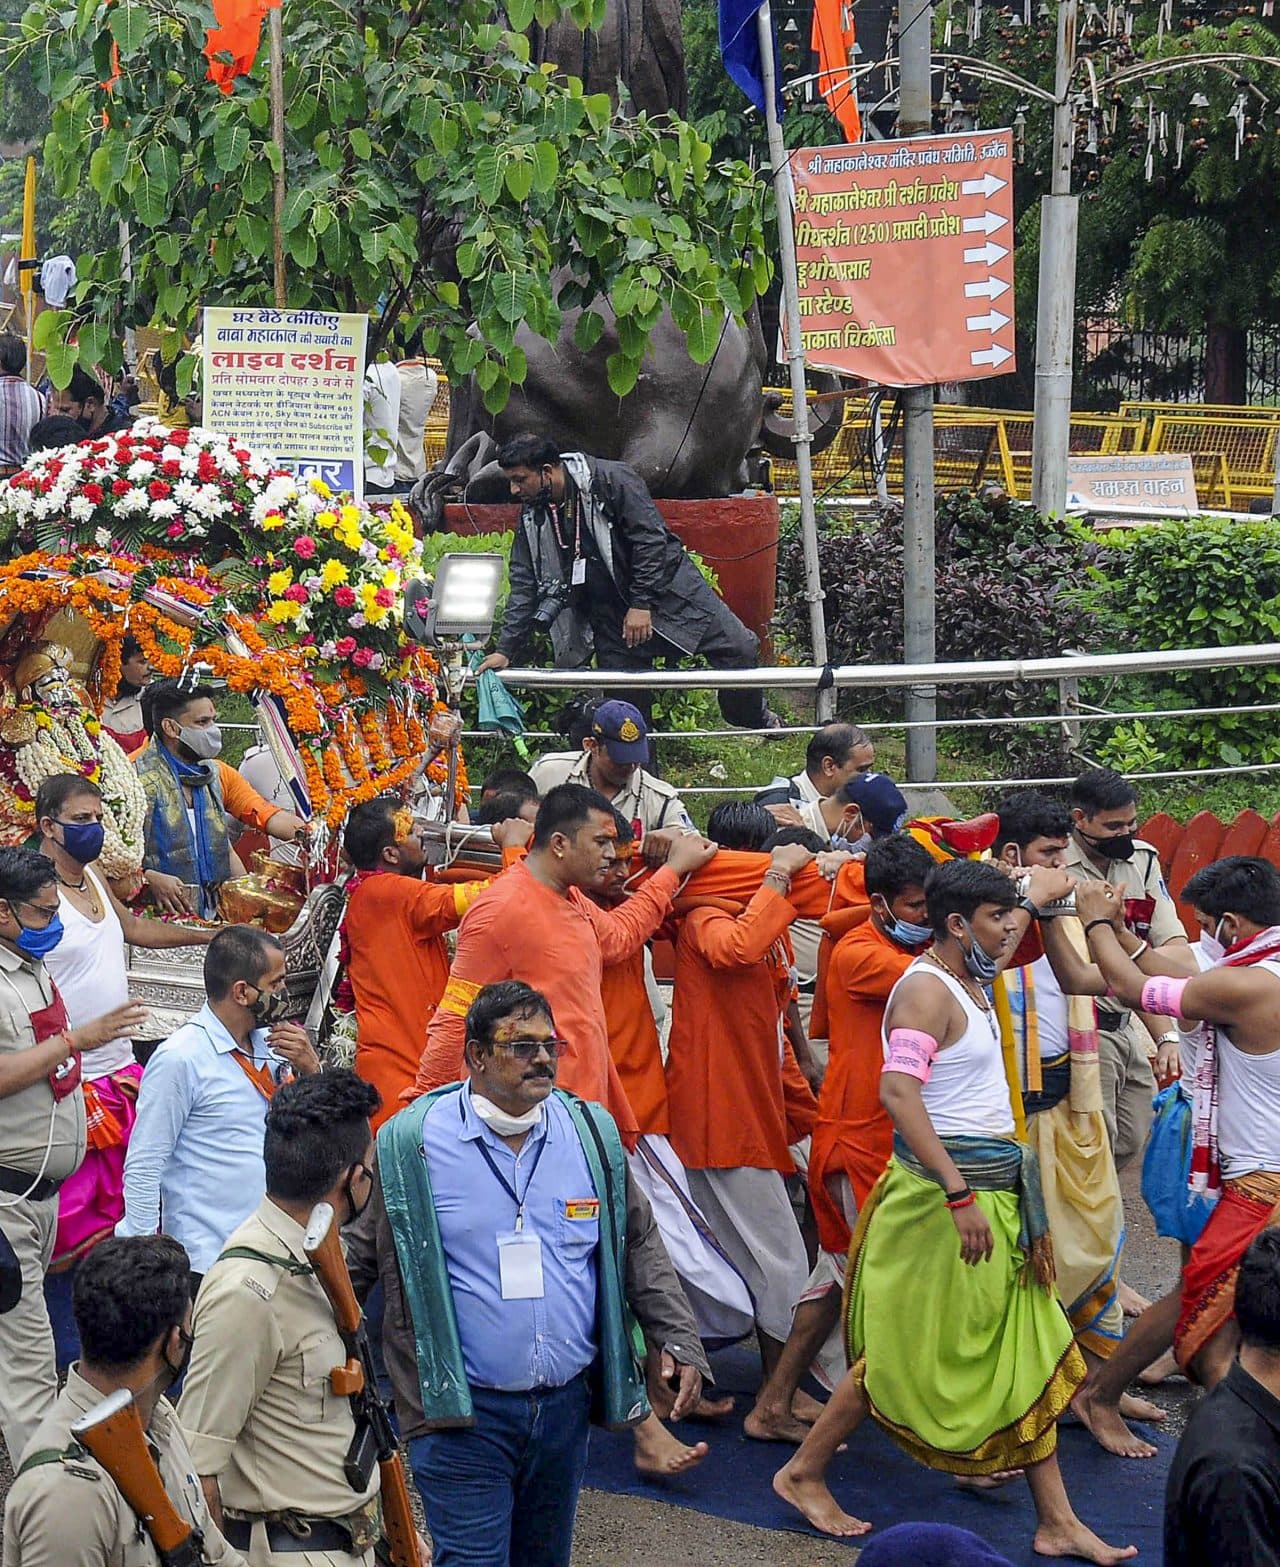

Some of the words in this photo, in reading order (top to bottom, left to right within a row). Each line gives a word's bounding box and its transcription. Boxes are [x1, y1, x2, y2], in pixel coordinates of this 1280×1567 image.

[808, 154, 822, 175] श्री
[823, 149, 887, 174] महाकालेश्वर
[888, 146, 916, 168] मंदिर
[809, 181, 881, 216] महाकालेश्वर
[899, 176, 928, 205] दर्शन
[928, 174, 959, 204] प्रवेश
[890, 210, 928, 241] प्रसादी
[929, 208, 961, 238] प्रवेश
[233, 312, 254, 323] घर
[258, 310, 282, 323] बैठे
[286, 310, 339, 331] कीजिए
[217, 328, 243, 342] बाबा
[247, 328, 298, 344] महाकाल
[211, 352, 285, 371] लाइव
[291, 348, 357, 372] दर्शन
[211, 371, 232, 386] प्रति
[235, 372, 276, 386] सोमवार
[278, 372, 308, 387] दोपहर
[312, 377, 318, 387] 3
[322, 375, 341, 388] बजे
[344, 376, 354, 389] से
[1091, 479, 1140, 498] समस्त
[1143, 478, 1185, 497] वाहन
